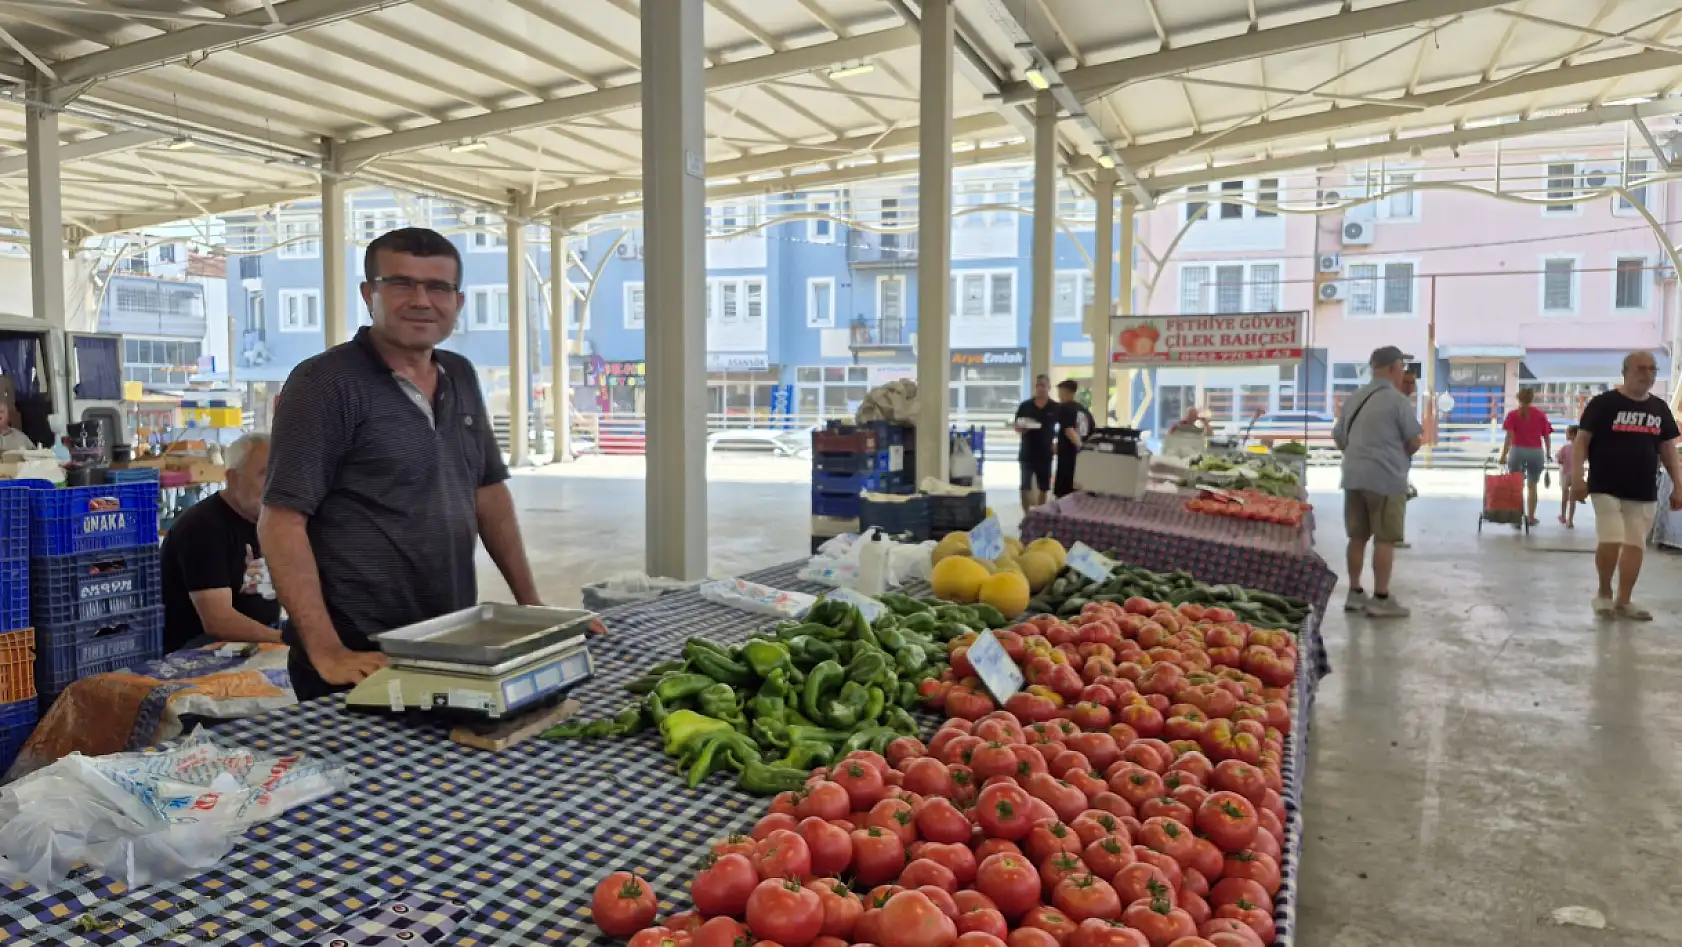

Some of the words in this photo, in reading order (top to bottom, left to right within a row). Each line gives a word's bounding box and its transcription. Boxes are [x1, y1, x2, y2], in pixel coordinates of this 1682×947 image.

[1166, 316, 1235, 331] FETHİYE
[1240, 315, 1297, 331] GÜVEN
[1165, 331, 1215, 348] ÇİLEK
[1220, 330, 1296, 348] BAHÇESİ
[1613, 411, 1646, 425] JUST
